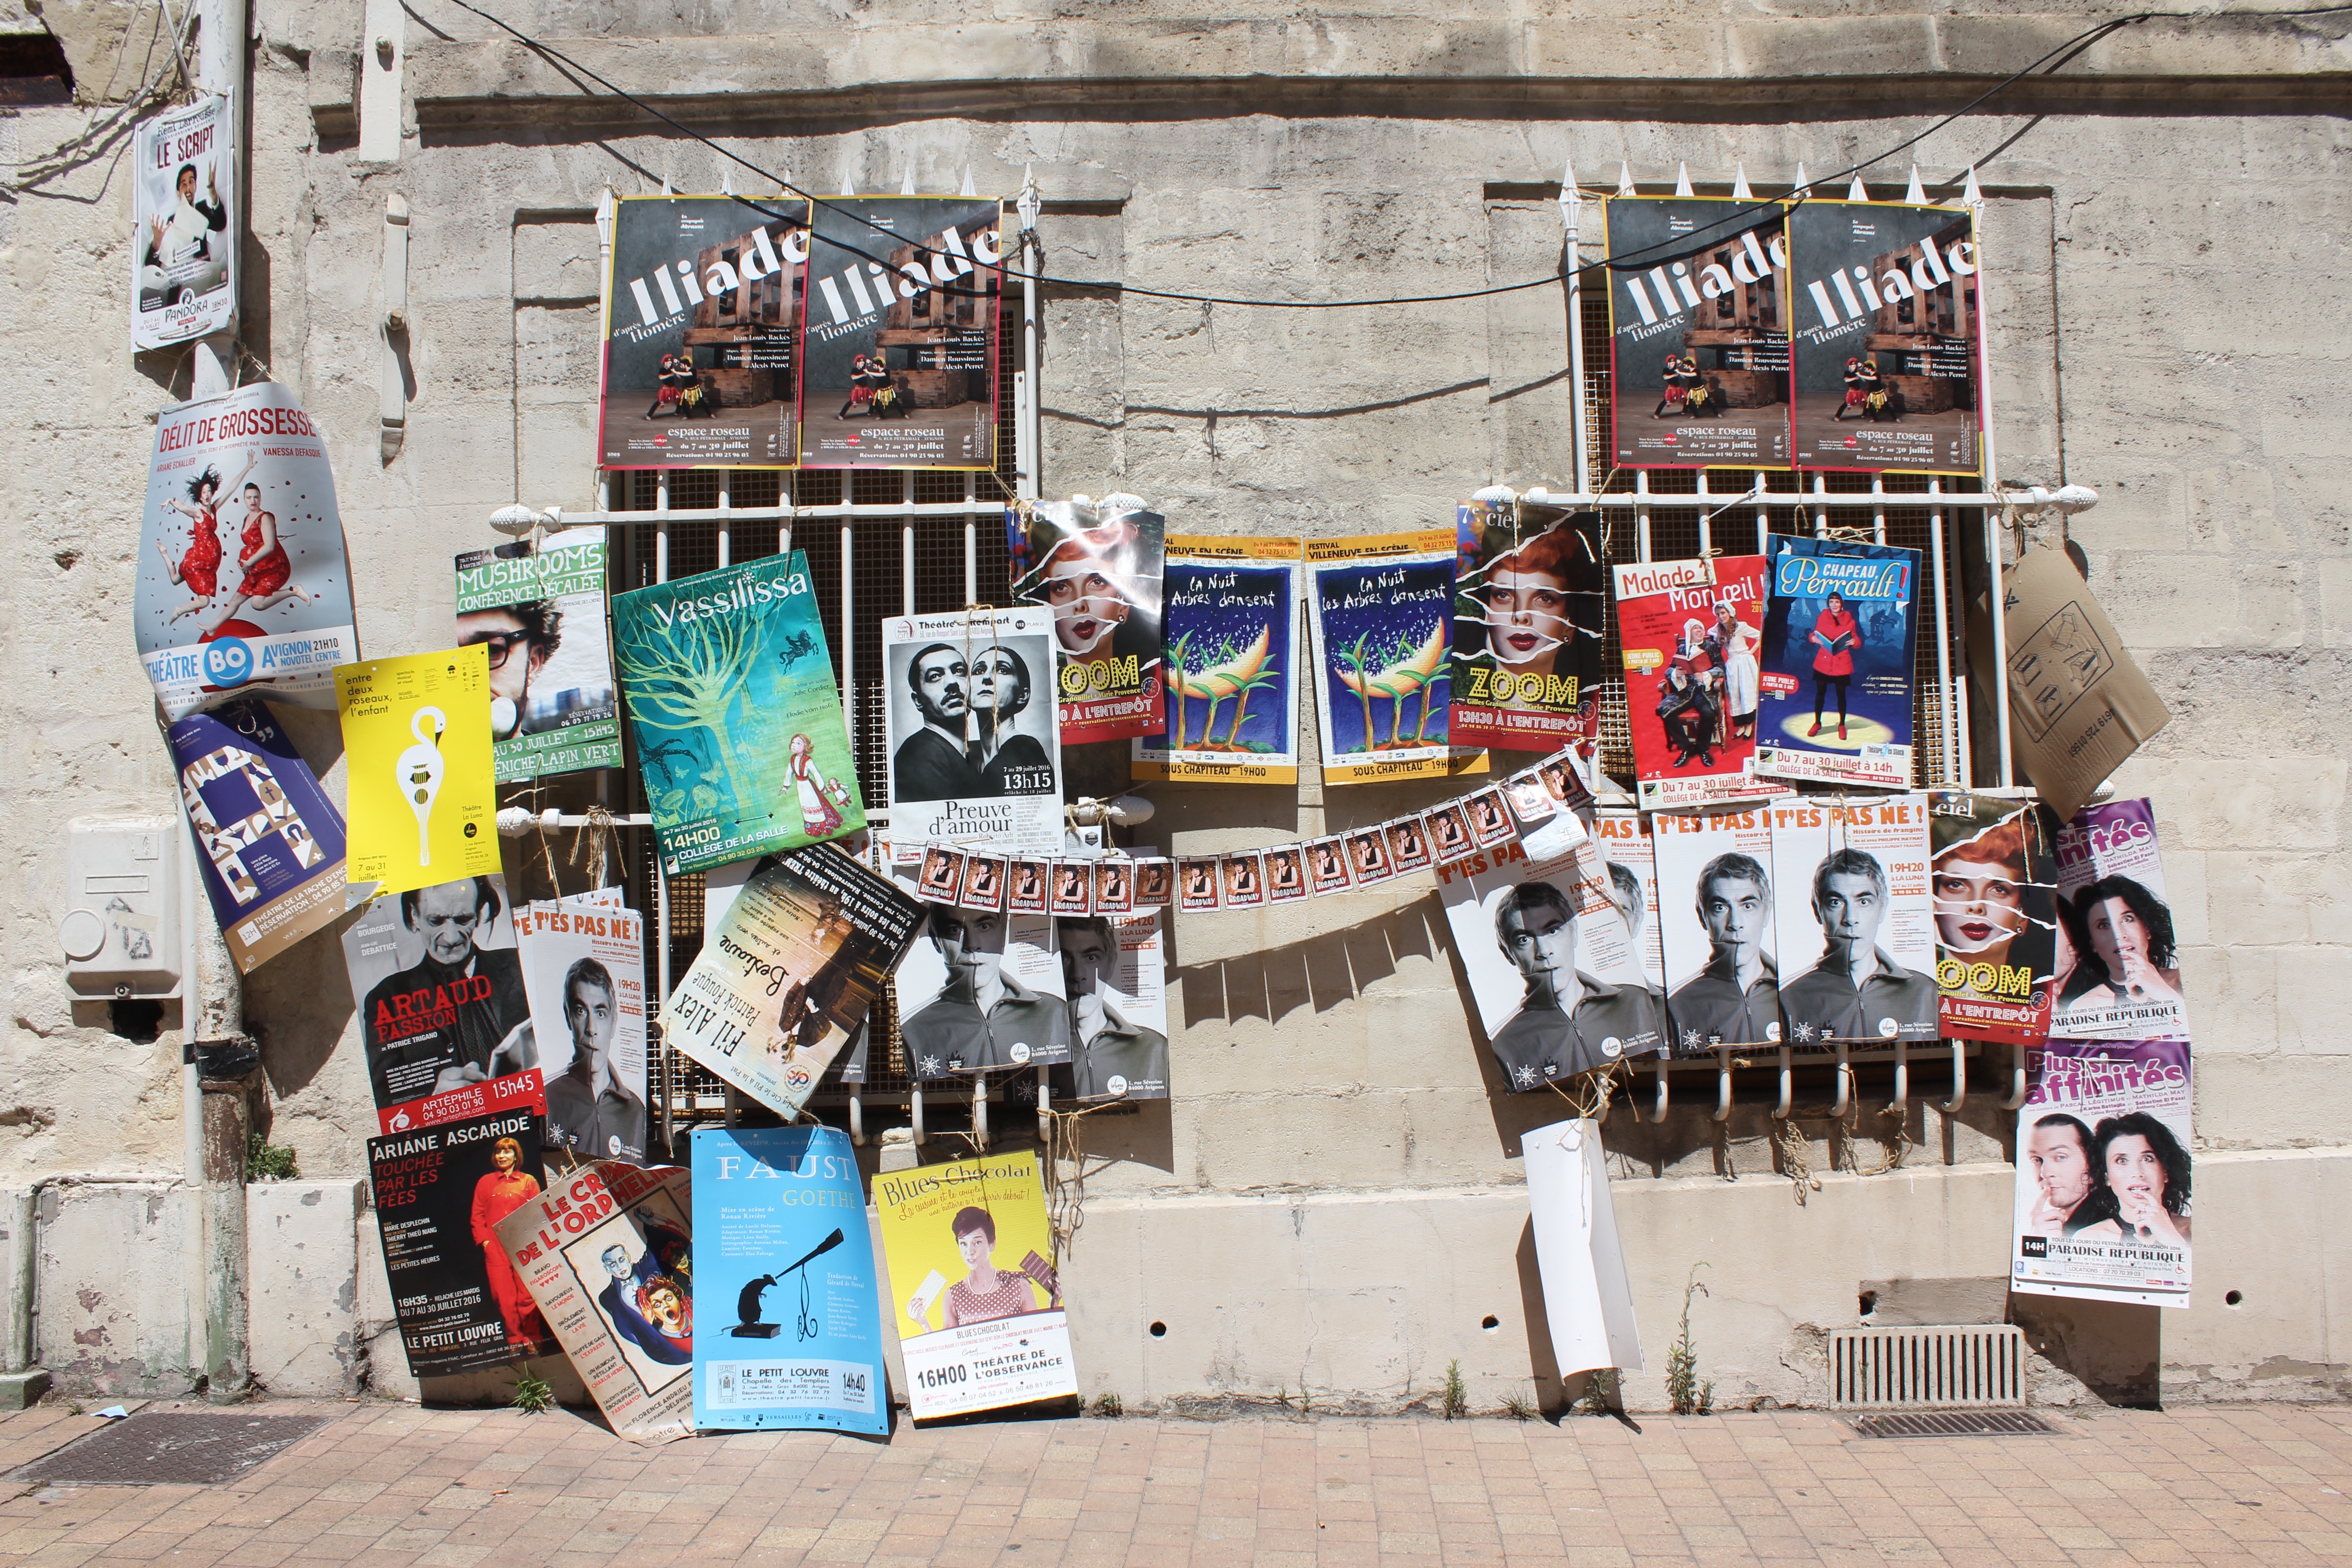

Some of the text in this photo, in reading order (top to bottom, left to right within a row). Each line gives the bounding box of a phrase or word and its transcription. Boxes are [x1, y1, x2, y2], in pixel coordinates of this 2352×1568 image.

[157, 123, 215, 169] LE SCRIPT
[165, 299, 207, 323] PANDORA
[212, 297, 227, 309] 18H30
[630, 312, 686, 344] Homère
[159, 408, 317, 453] DÉLIT DE GROSSESSE
[668, 427, 750, 438] espace roseau
[1676, 426, 1756, 438] espace roseau
[263, 448, 322, 457] VANESSA DEFASQUE
[723, 441, 749, 451] juillet
[157, 457, 196, 472] ARIANE ECHALLIER
[457, 542, 603, 595] MUSHROOMS
[1781, 558, 1901, 598] Perrault
[1823, 563, 1877, 580] CHAPEAU,
[1622, 566, 1695, 596] Malade
[457, 573, 600, 612] CONFÉRENCE DÉCALÉE
[652, 572, 808, 627] Vassilissa
[1171, 590, 1276, 608] Arbres dansent
[1344, 593, 1383, 609] Arbres
[1391, 583, 1446, 606] dansent
[1669, 576, 1756, 612] Mon œil
[208, 647, 248, 674] BO
[261, 638, 338, 668] AVIGNON 21H10
[281, 650, 341, 666] NOVOTEL CENTRE
[146, 651, 199, 684] THÉÂTRE
[346, 673, 372, 685] entre
[348, 684, 373, 696] deux
[793, 683, 830, 696] Julie Cordier
[1468, 667, 1578, 705] ZOOM
[349, 694, 392, 706] roseaux,
[1485, 700, 1517, 708] Granouillet
[1545, 705, 1577, 713] Provence
[1458, 710, 1493, 725] 13H30
[1495, 710, 1504, 726] À
[526, 724, 614, 750] JUILLET 15H45
[541, 742, 619, 766] LAPIN VERT
[1004, 772, 1051, 789] 13h15
[1160, 764, 1266, 777] SOUS CHAPITEAU 19H00
[944, 801, 1012, 820] Preuve
[1826, 808, 1875, 828] PAS
[1878, 802, 1911, 824] NÉ
[1935, 798, 1974, 817] ciel
[663, 826, 721, 852] 14H00
[679, 825, 788, 861] COLLÈGE DE LA SALLE
[358, 873, 378, 883] juillet
[1889, 863, 1924, 872] 19H20
[254, 880, 326, 924] THÉÂTRE DE LA TACHE
[965, 893, 997, 905] BROADWAY
[1011, 898, 1043, 907] BROADWAY
[1183, 897, 1215, 907] BROADWAY
[1271, 887, 1303, 898] BROADWAY
[259, 899, 309, 931] RÉSERVATION
[1098, 900, 1129, 910] BROADWAY
[242, 928, 257, 941] 12H
[357, 923, 396, 937] BOURGEOIS
[362, 942, 398, 956] DEBATTICE
[719, 935, 789, 997] Bestiaire
[617, 978, 641, 990] 19H20
[373, 975, 492, 1026] ARTAUD
[691, 971, 760, 1027] Patrick Fouque
[376, 1008, 457, 1042] PASSION
[674, 993, 745, 1057] Fil Alex
[387, 1032, 438, 1050] PATRICE TRIGANO
[2026, 1051, 2109, 1073] Plus si
[492, 1075, 534, 1099] 15h45
[2024, 1058, 2185, 1105] affinités
[422, 1088, 482, 1112] ARTÉPHILE
[374, 1116, 530, 1162] ARIANE ASCARIDE
[375, 1152, 445, 1178] TOUCHÉE
[716, 1155, 851, 1181] FAUST
[376, 1170, 438, 1194] PAR LES
[882, 1164, 1031, 1207] Blues Chocolat
[378, 1189, 416, 1209] FÉES
[541, 1196, 572, 1222] LE
[783, 1189, 856, 1209] GOETHE
[384, 1218, 430, 1232] MARIE DESPLECHIN
[516, 1241, 543, 1267] DE
[2024, 1241, 2044, 1252] 14H
[2048, 1244, 2185, 1263] PARADISE REPUBLIQUE
[529, 1263, 563, 1286] FIGAROSCOPE
[398, 1295, 428, 1307] 16H35
[407, 1322, 503, 1348] LE PETIT LOUVRE
[973, 1349, 1046, 1369] THÉÂTRE DE
[843, 1371, 865, 1392] 14h40
[917, 1363, 967, 1389] 16H00
